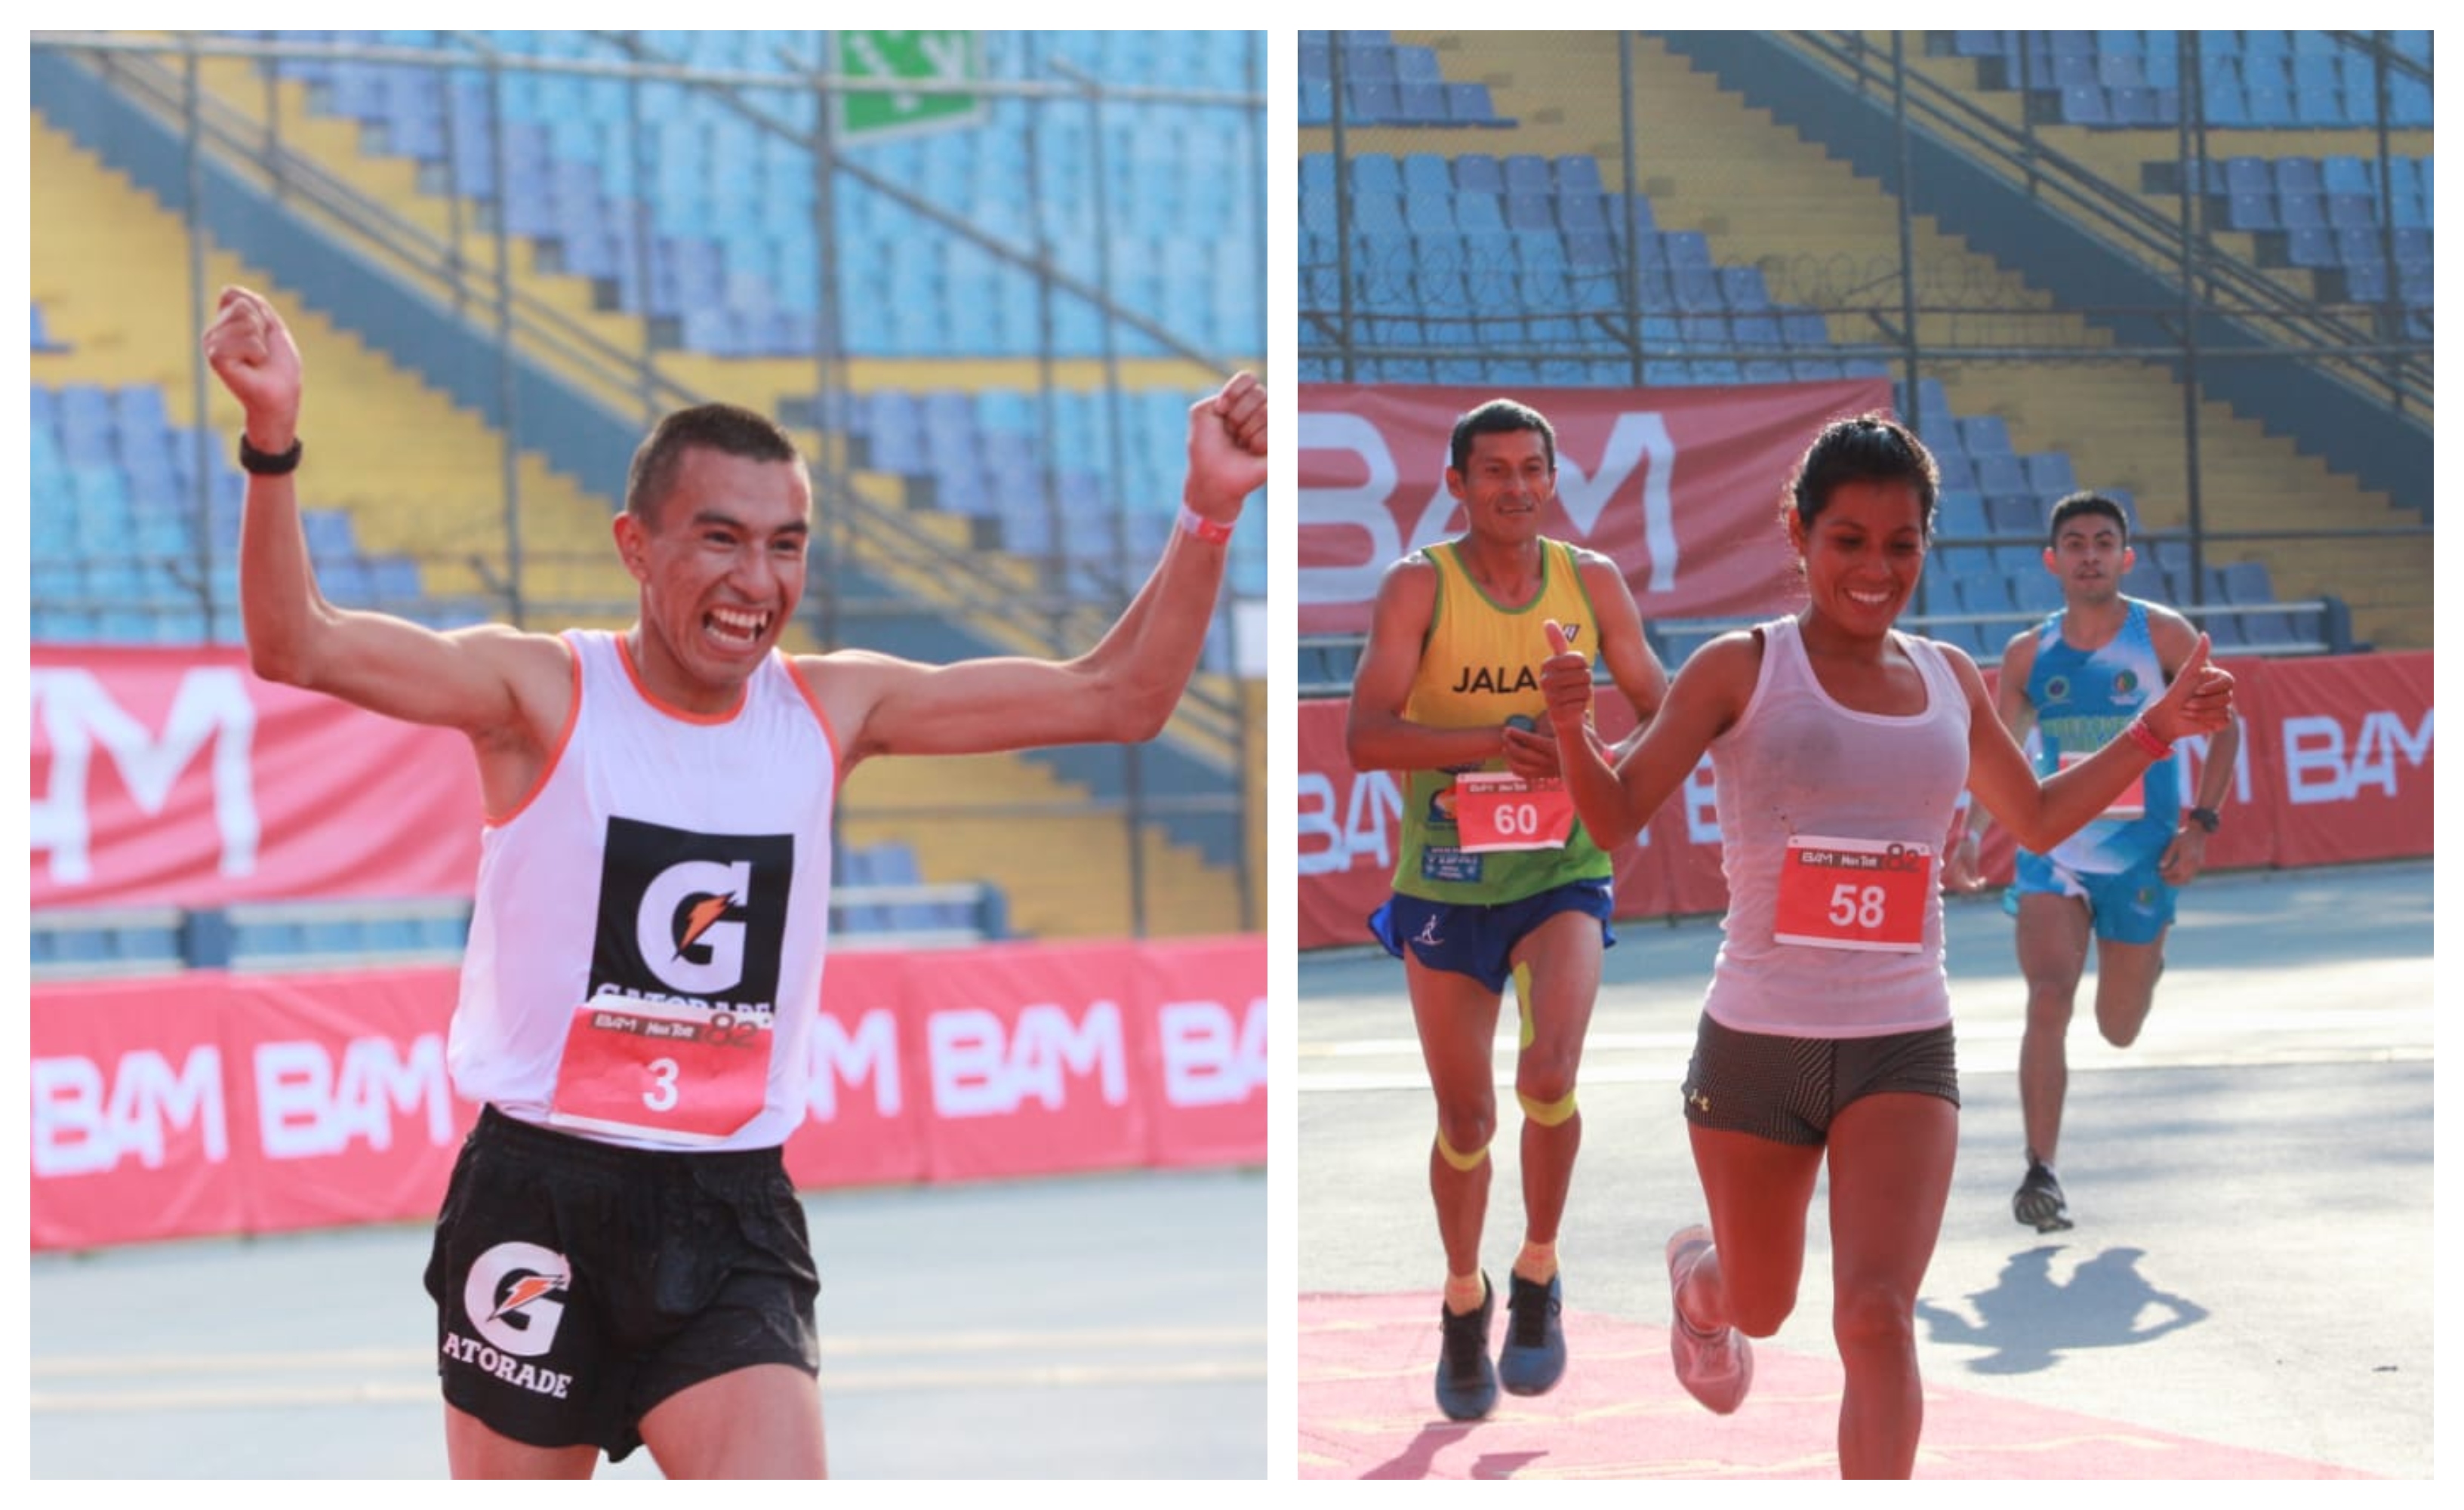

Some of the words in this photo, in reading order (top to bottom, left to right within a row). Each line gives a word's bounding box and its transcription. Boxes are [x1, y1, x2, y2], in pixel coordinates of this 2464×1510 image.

[1452, 666, 1538, 693] JALA
[1494, 803, 1538, 836] 60
[636, 860, 752, 994] G
[1828, 883, 1886, 929] 58
[253, 1034, 453, 1160] BAM
[642, 1059, 679, 1111] 3
[926, 1000, 1129, 1119] BAM
[30, 1045, 229, 1178] BAM
[464, 1240, 571, 1357] G
[442, 1332, 572, 1399] ATORADE
